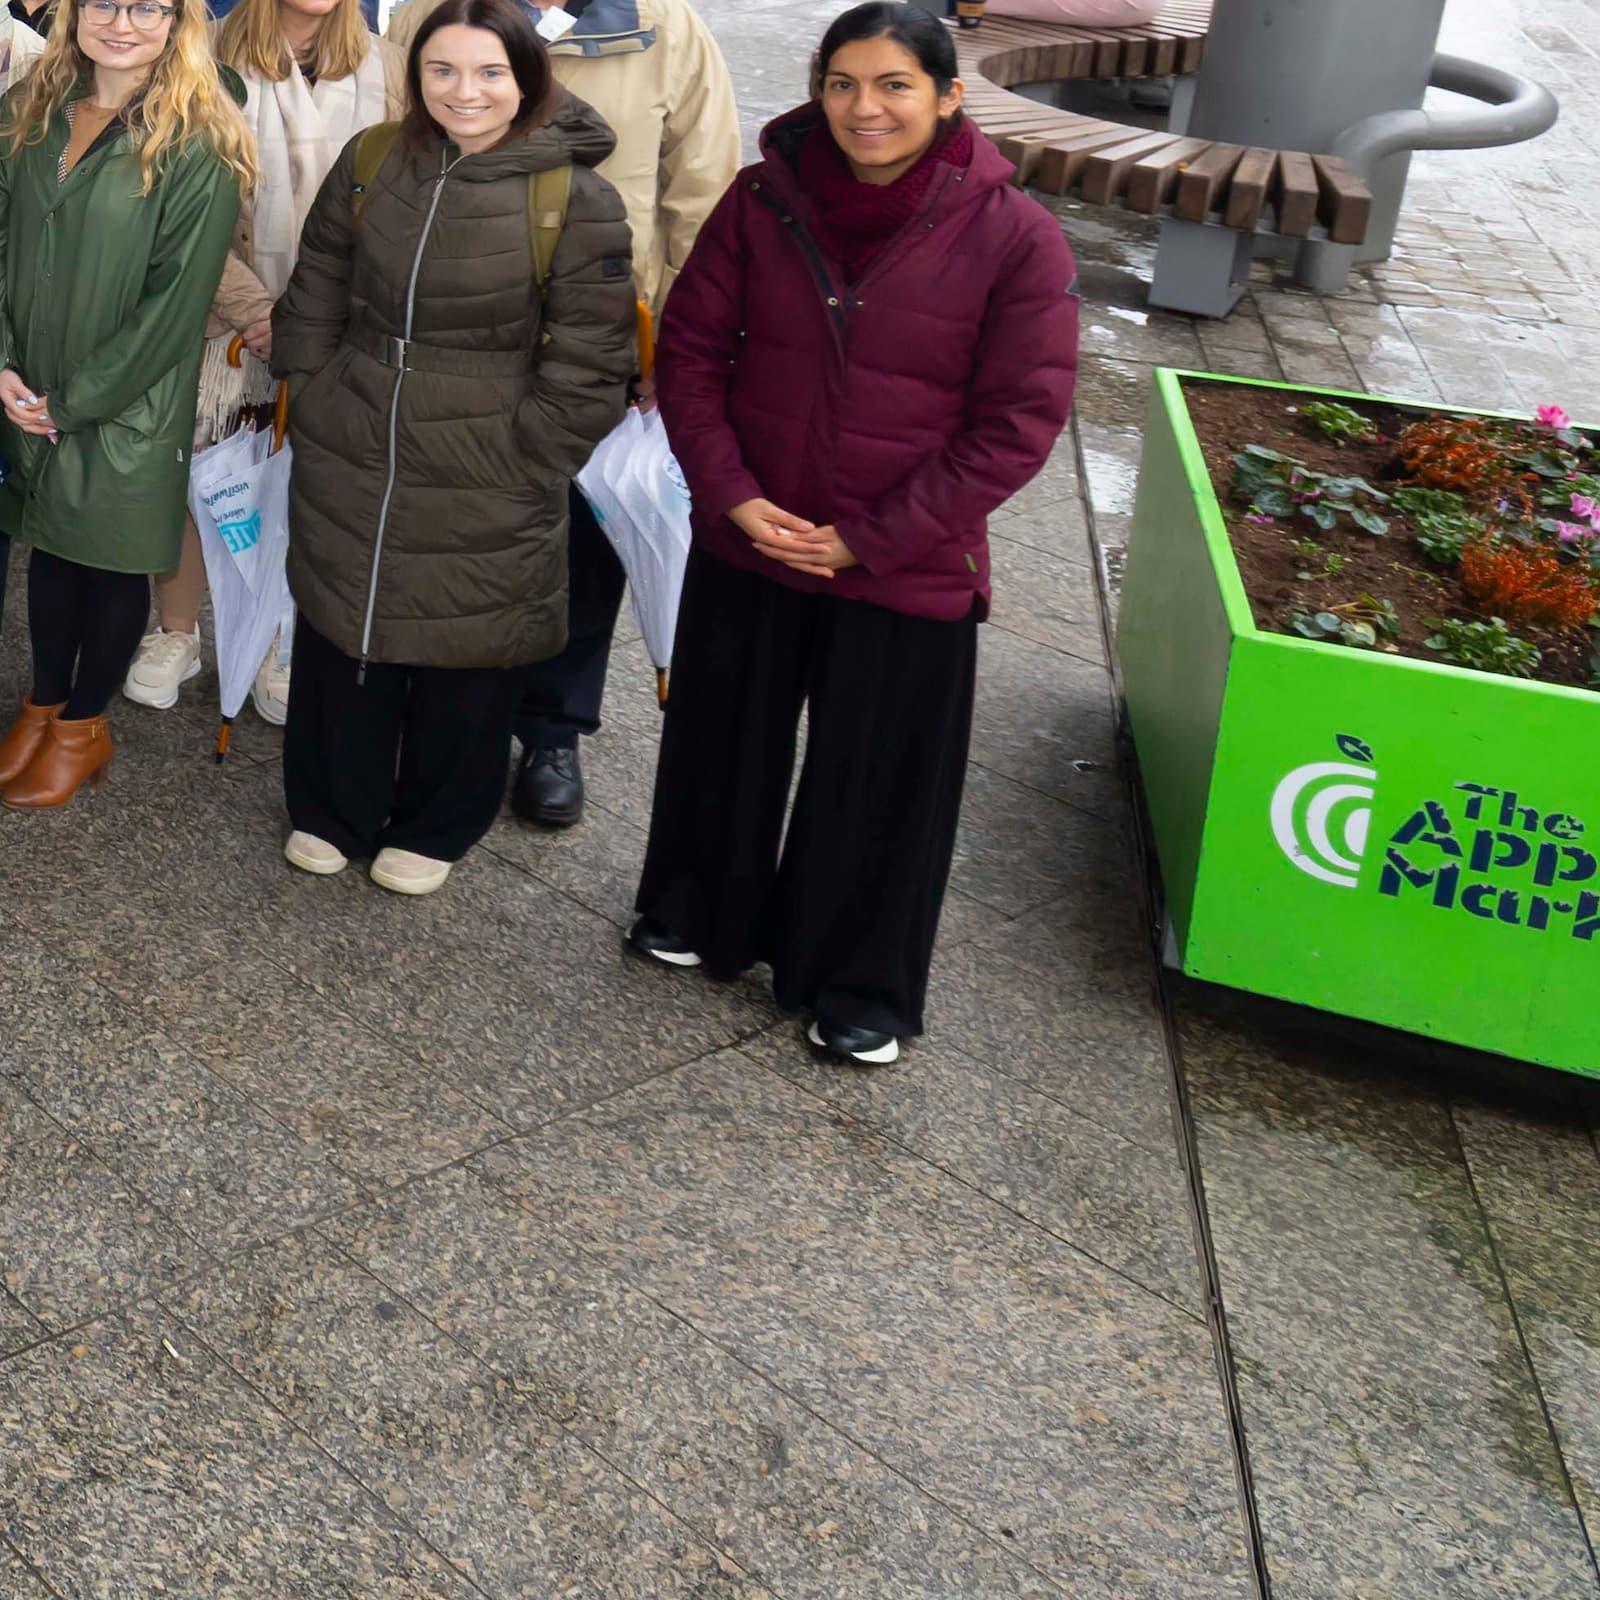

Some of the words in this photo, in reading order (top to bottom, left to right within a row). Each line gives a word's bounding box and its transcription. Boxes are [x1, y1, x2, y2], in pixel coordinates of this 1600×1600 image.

[1388, 799, 1598, 888] App
[1453, 782, 1585, 841] The
[1377, 846, 1600, 942] Mark
